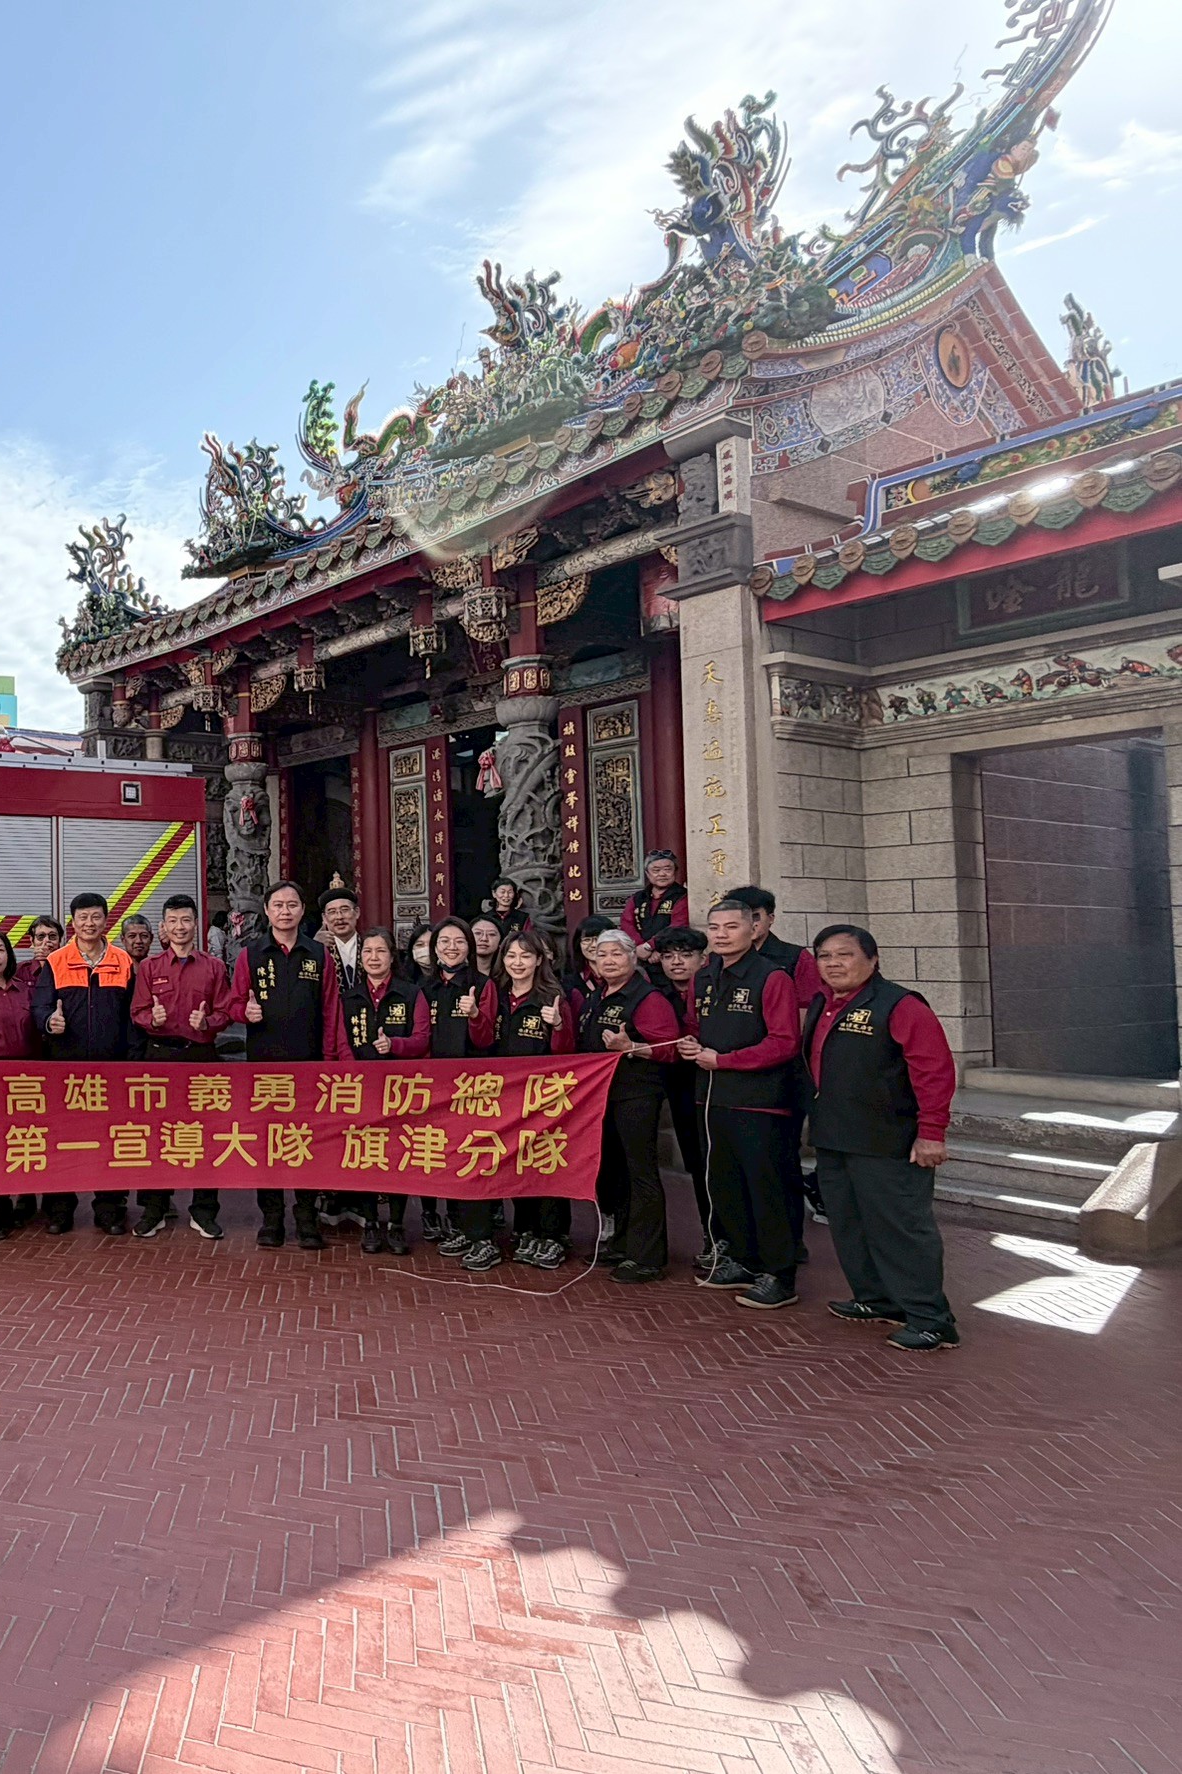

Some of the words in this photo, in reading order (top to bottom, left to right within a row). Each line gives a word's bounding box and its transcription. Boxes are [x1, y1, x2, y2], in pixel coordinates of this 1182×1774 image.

[2, 1070, 579, 1119] 高雄市義勇消防總隊
[4, 1121, 314, 1173] 第一宣導大隊
[341, 1123, 568, 1178] 旗津分隊
